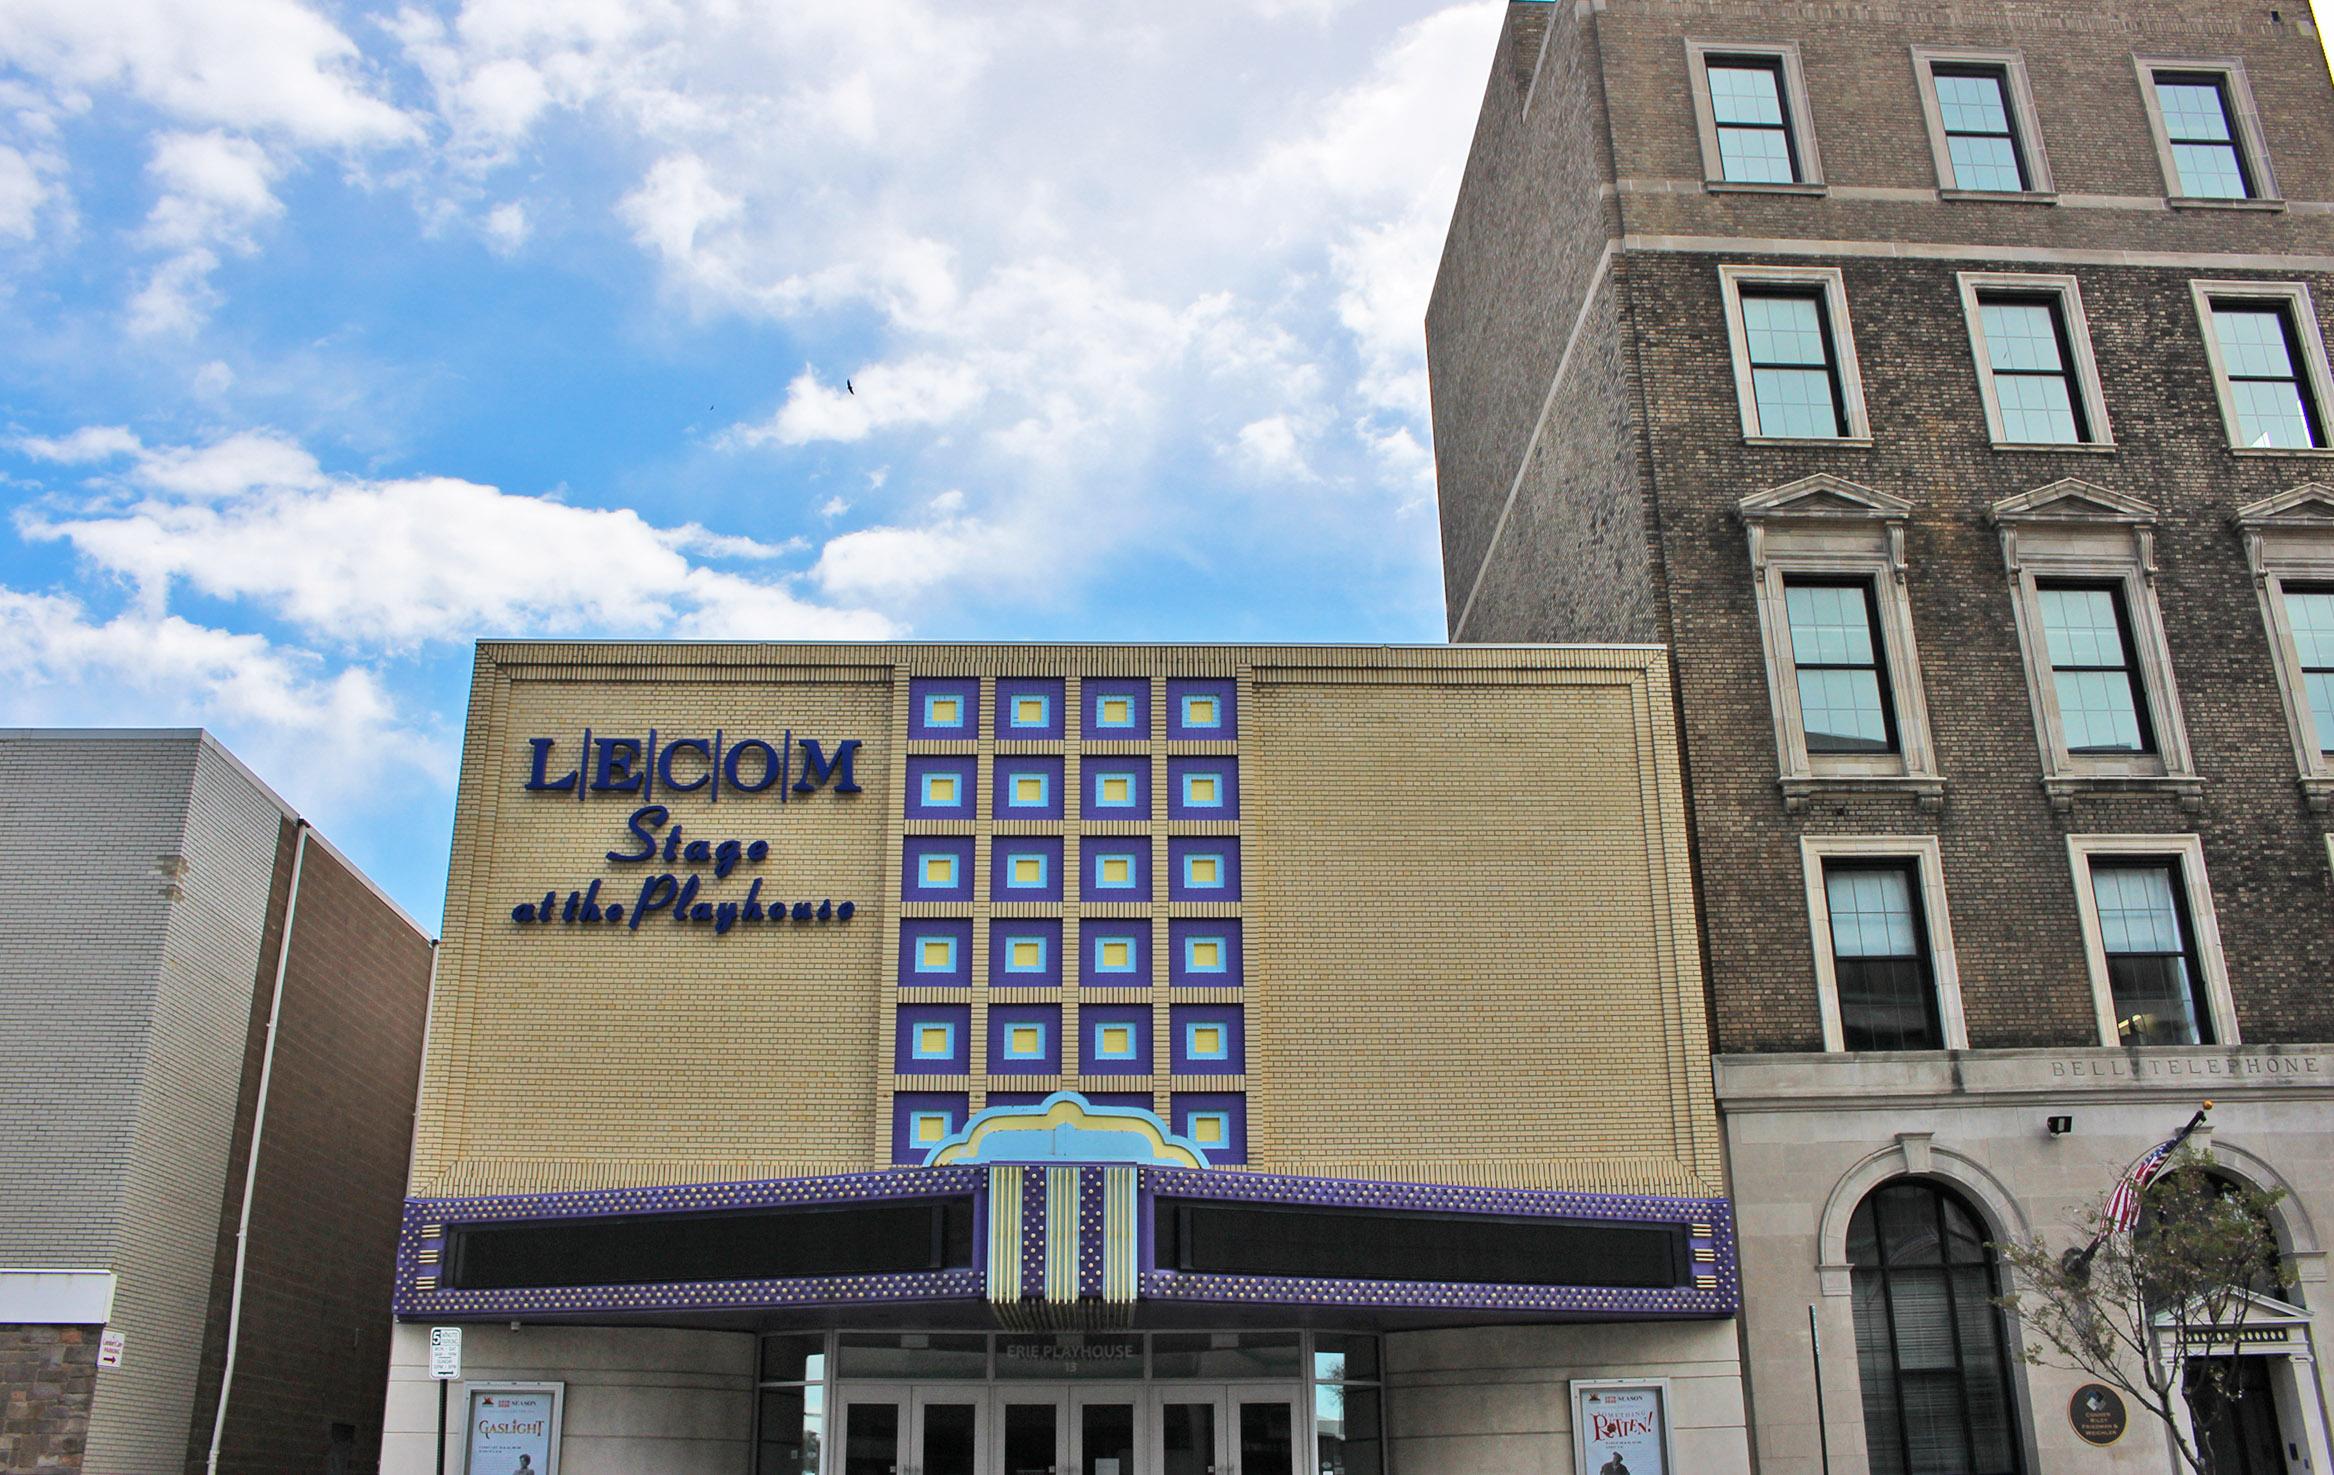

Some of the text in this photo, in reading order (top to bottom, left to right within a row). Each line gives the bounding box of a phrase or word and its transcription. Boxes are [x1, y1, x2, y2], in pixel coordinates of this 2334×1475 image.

[606, 805, 769, 879] Stage
[511, 873, 856, 935] at the Playhouse
[2052, 1057, 2320, 1077] BELL TELEPHONE
[432, 1330, 441, 1345] 5
[1006, 1344, 1134, 1358] ERIE PLAYHOUSE
[1064, 1361, 1078, 1373] 13
